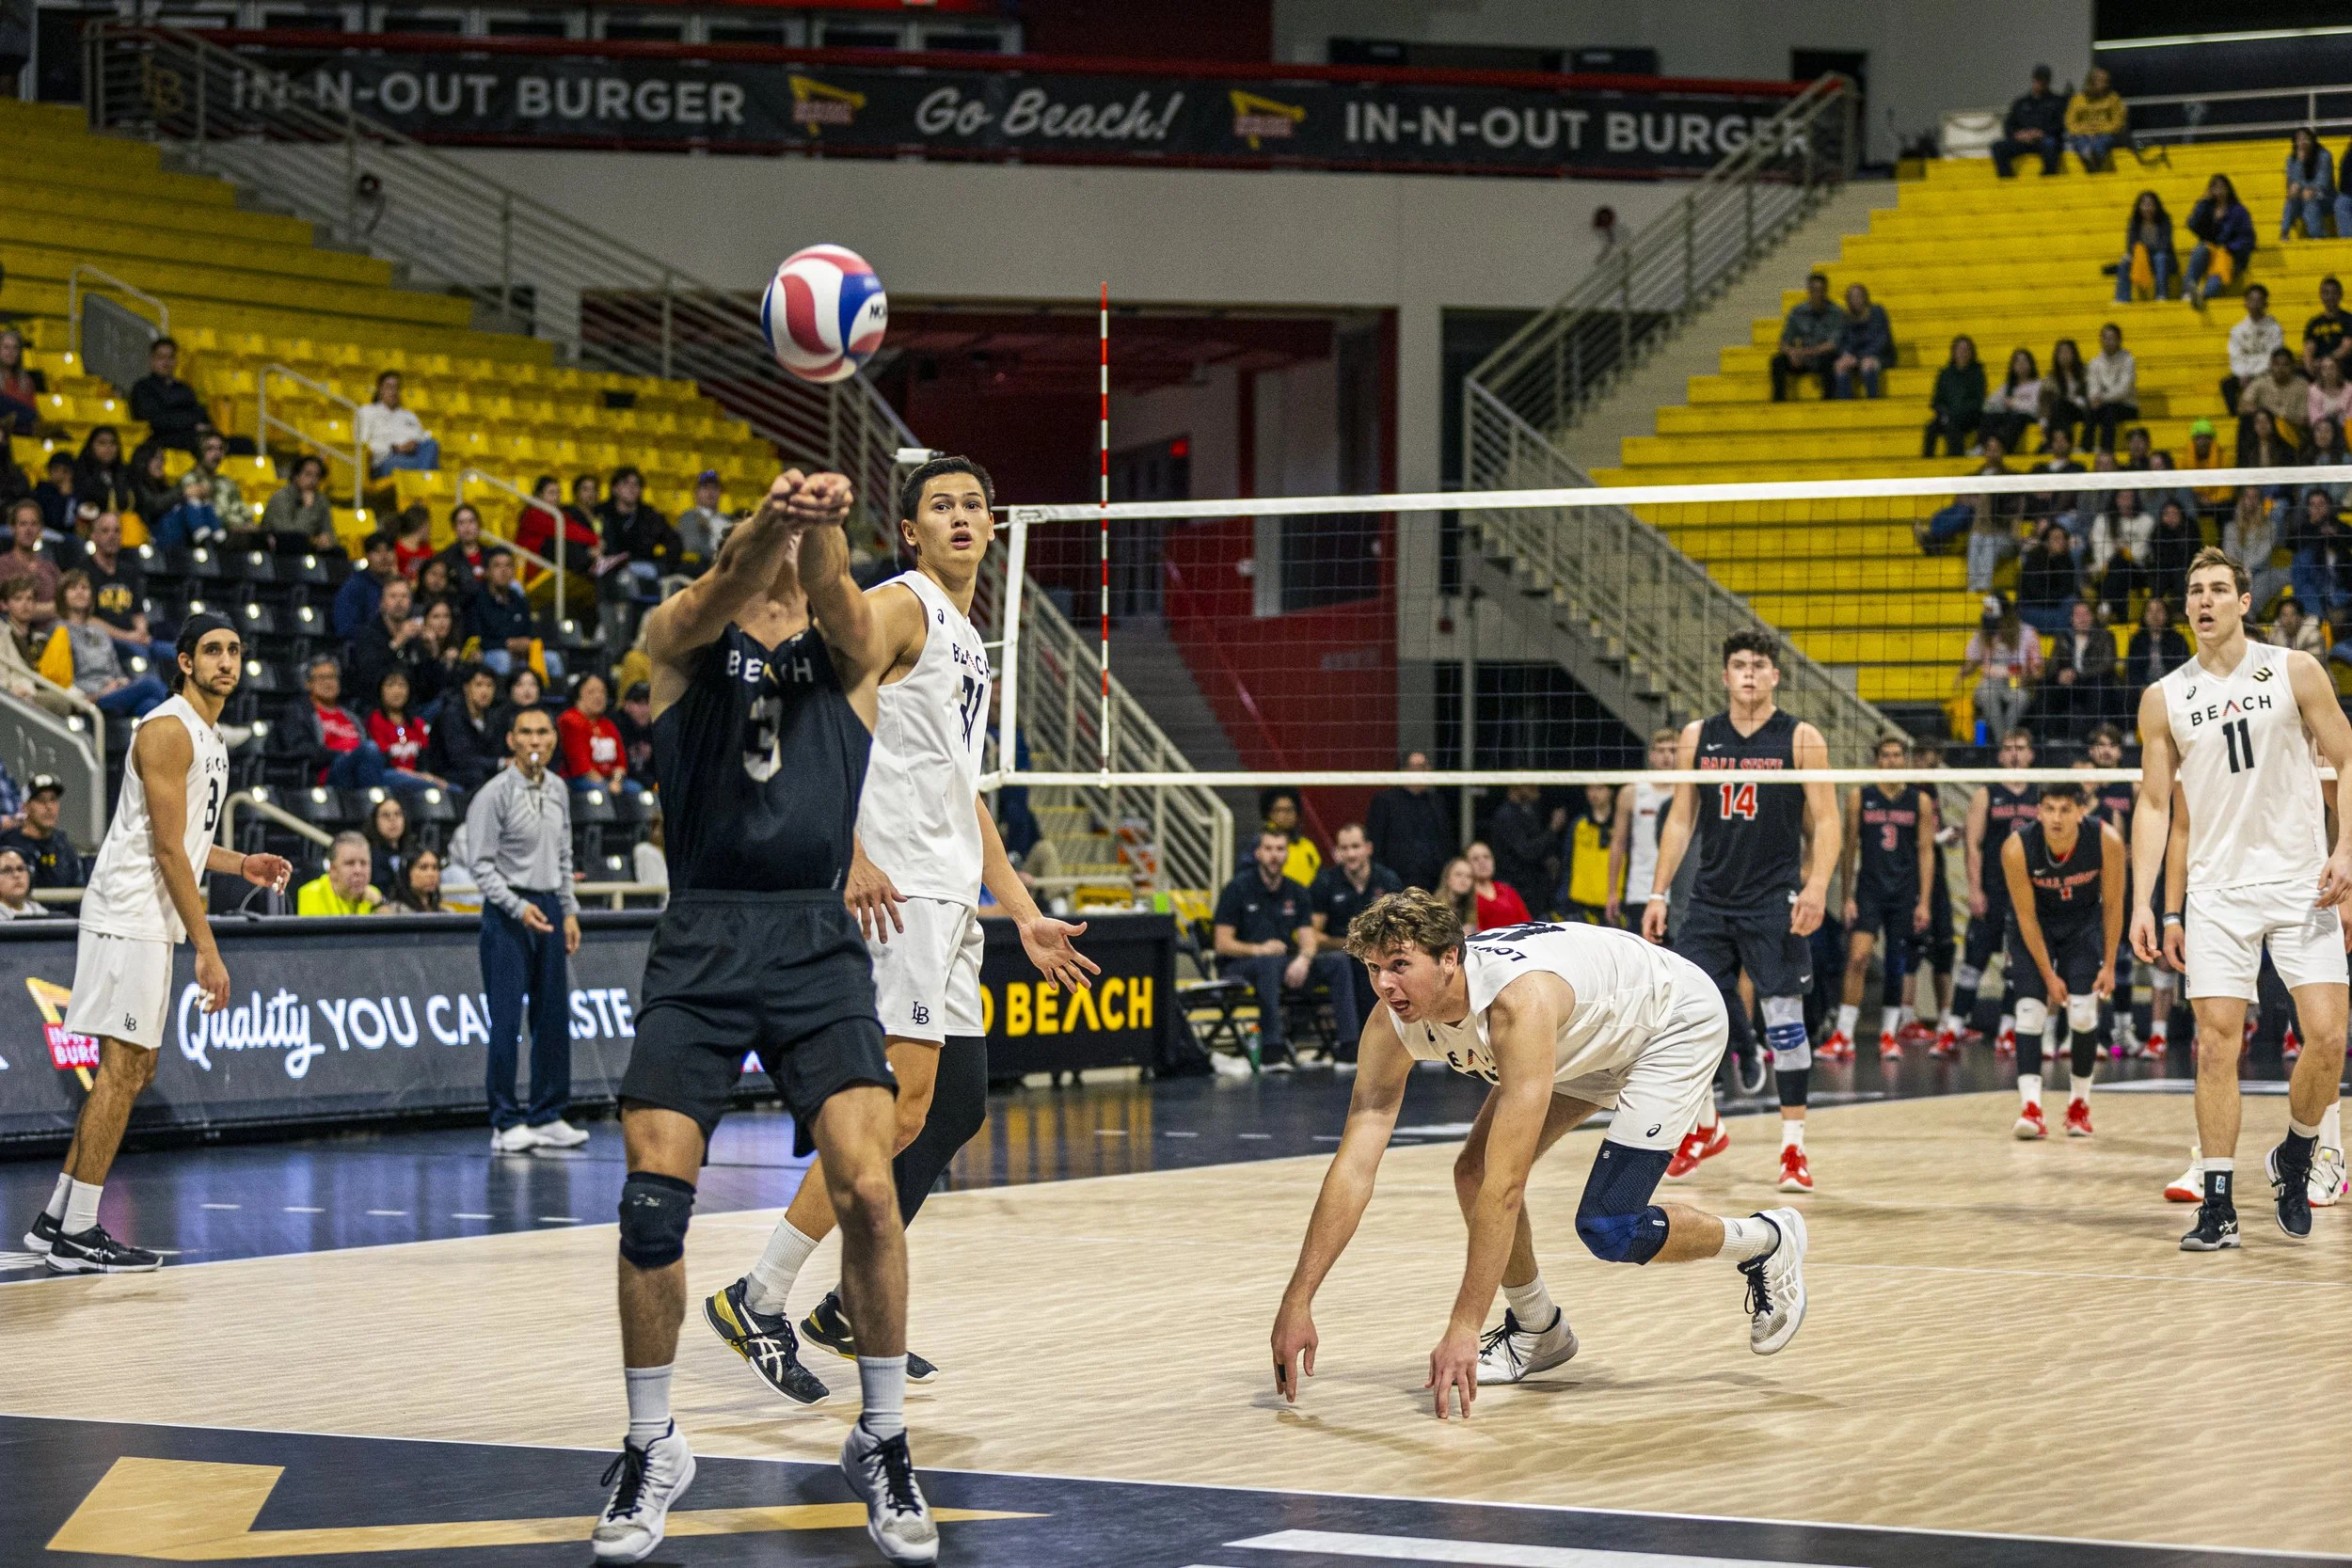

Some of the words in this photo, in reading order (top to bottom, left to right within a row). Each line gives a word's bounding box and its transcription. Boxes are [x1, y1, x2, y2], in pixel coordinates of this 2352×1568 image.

[231, 70, 499, 119] IN-N-OUT
[516, 75, 745, 125] BURGER
[914, 86, 994, 136] Go
[1001, 87, 1185, 141] Beach!
[1344, 101, 1590, 150] IN-N-OUT
[2190, 694, 2272, 727] BEACH
[2221, 718, 2255, 774] 11
[204, 777, 218, 832] 3
[1720, 782, 1757, 821] 14
[177, 981, 326, 1080] Quality
[316, 994, 420, 1052] YOU
